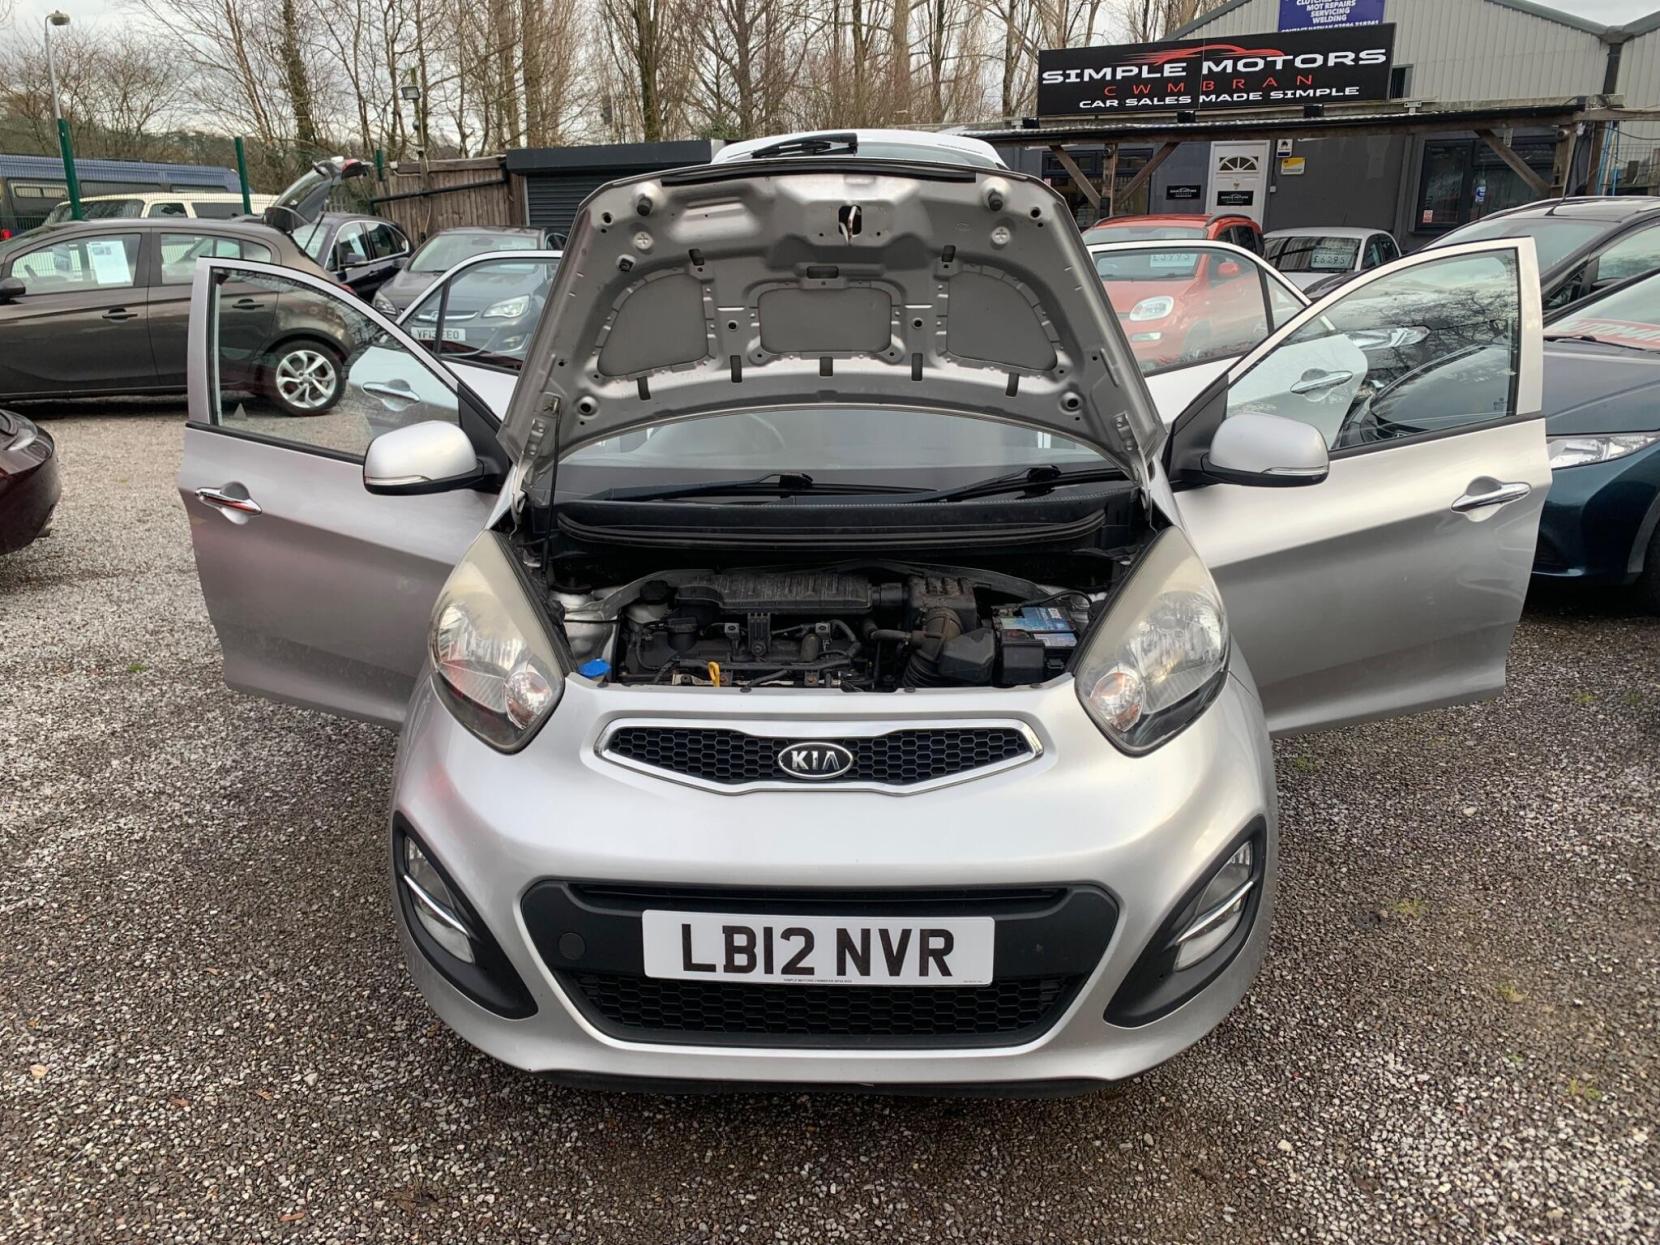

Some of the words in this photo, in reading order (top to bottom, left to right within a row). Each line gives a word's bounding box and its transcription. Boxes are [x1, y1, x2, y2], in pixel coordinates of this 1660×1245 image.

[1310, 8, 1350, 17] SERVICING
[1325, 0, 1356, 9] REPAIRS
[1312, 14, 1347, 23] WELDING
[1042, 63, 1187, 84] SIMPLE
[1202, 49, 1387, 75] MOTORS
[1079, 99, 1119, 109] CAR
[1125, 95, 1192, 107] SALES
[1199, 92, 1262, 103] MADE
[1269, 86, 1360, 99] SIMPLE
[791, 750, 840, 770] KIA
[681, 923, 815, 976] LB12
[836, 928, 954, 978] NVR
